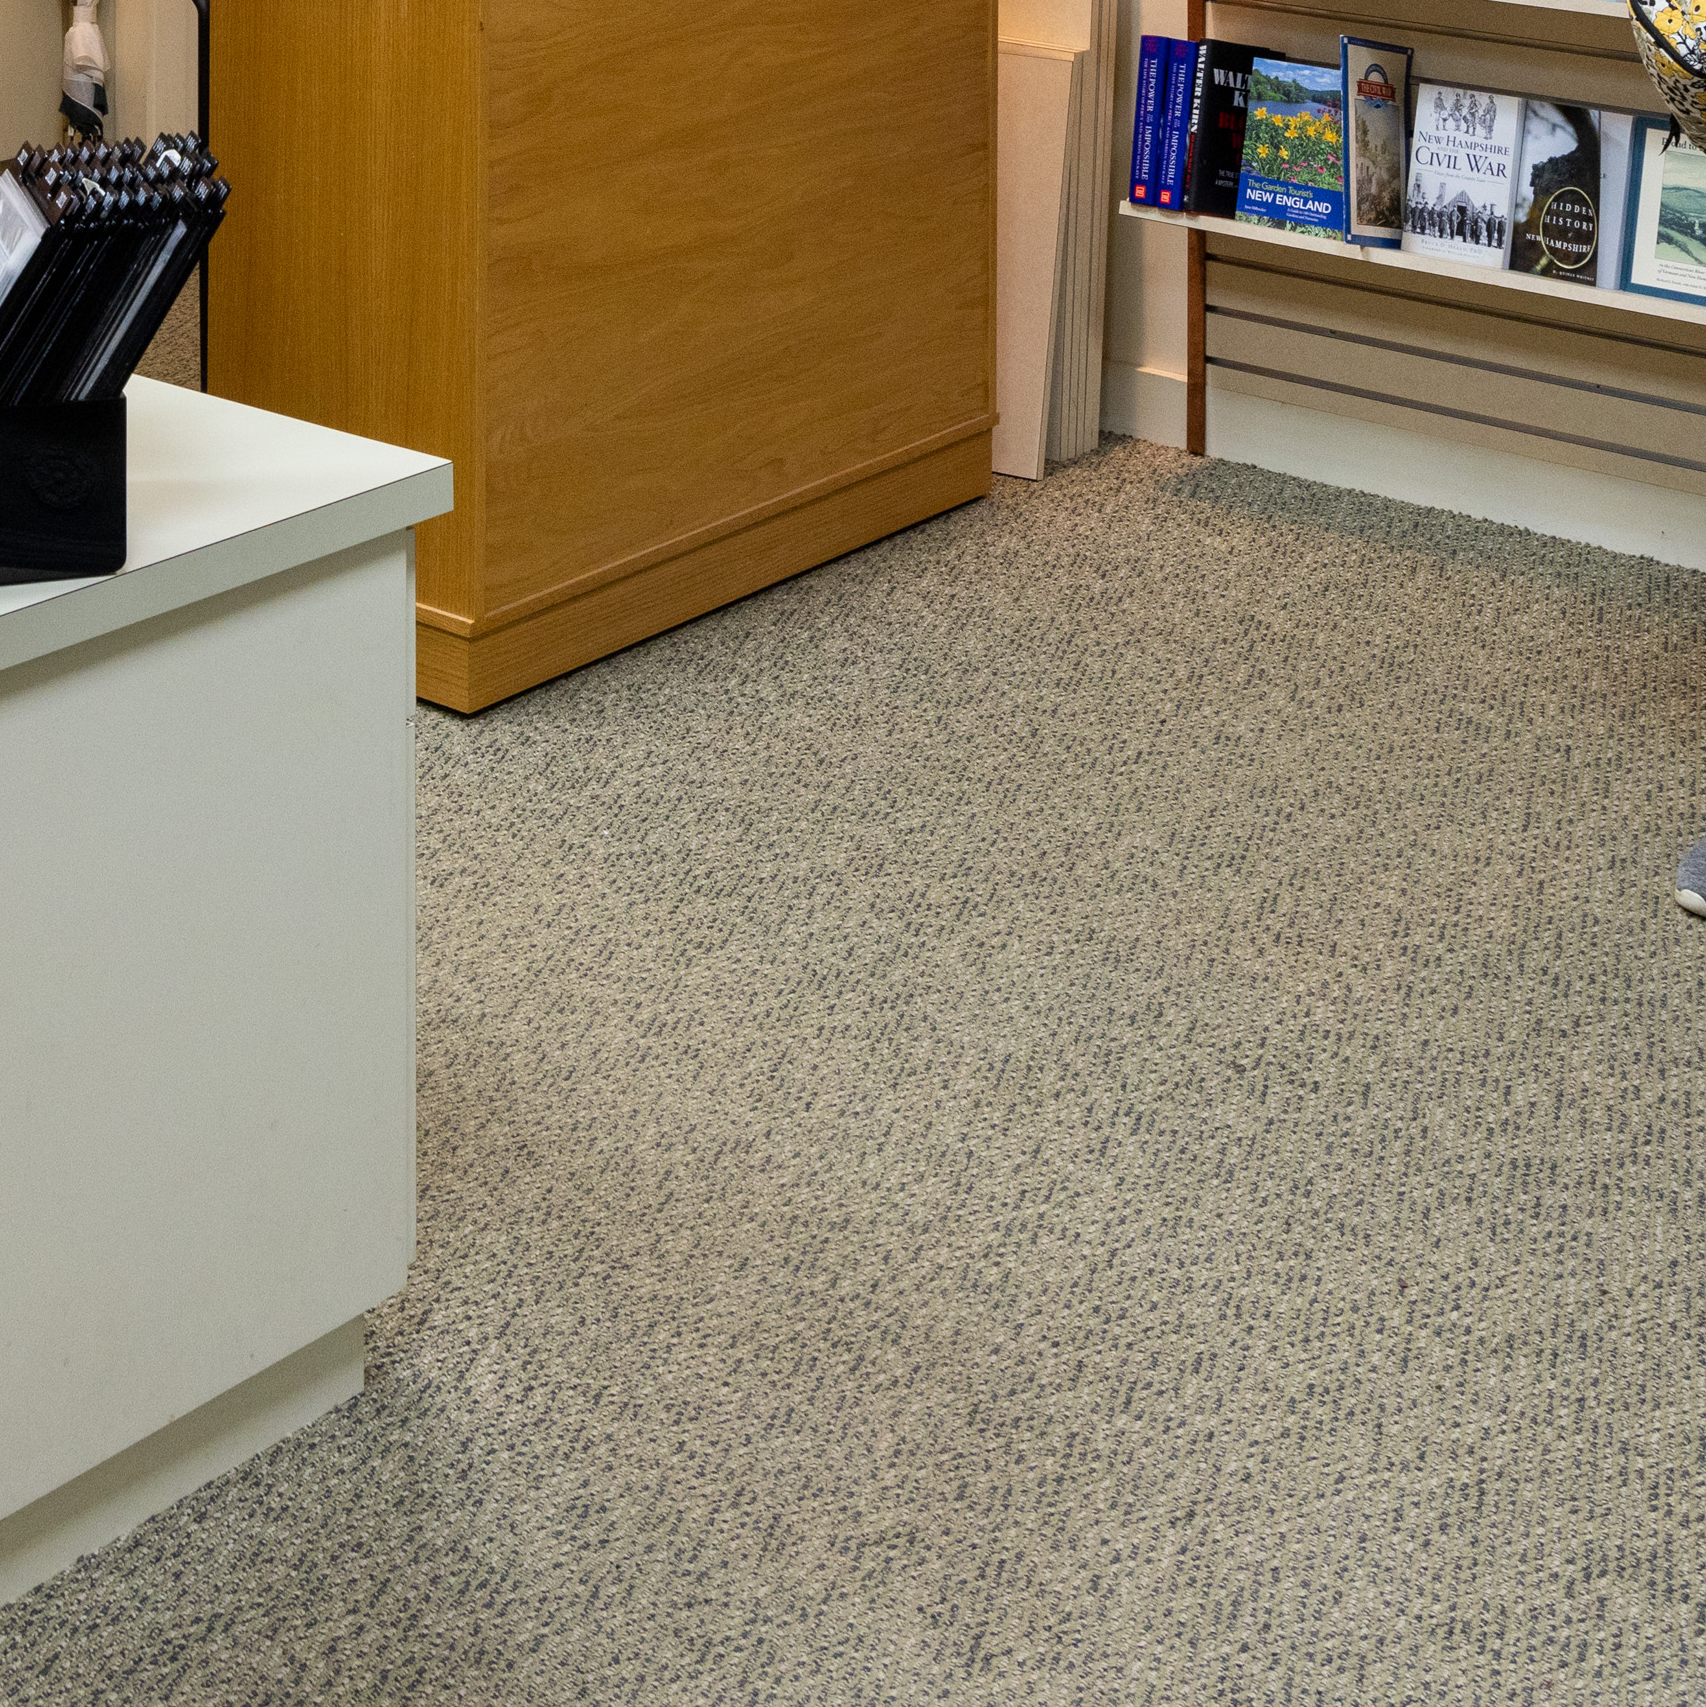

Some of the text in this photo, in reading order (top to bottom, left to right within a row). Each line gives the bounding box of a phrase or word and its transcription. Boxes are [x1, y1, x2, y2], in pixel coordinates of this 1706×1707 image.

[1190, 45, 1207, 133] WALTER KIRN
[1418, 131, 1510, 157] NEW HAMPSHIRE
[1415, 145, 1508, 179] CIVIL WAR
[1247, 179, 1313, 199] The Garden Tourist's
[1247, 189, 1332, 214] NEW ENGLAND
[1551, 202, 1593, 217] HIDDEN
[1545, 215, 1593, 232] HISTORY
[1526, 233, 1592, 253] NEW HAMPSHIRE
